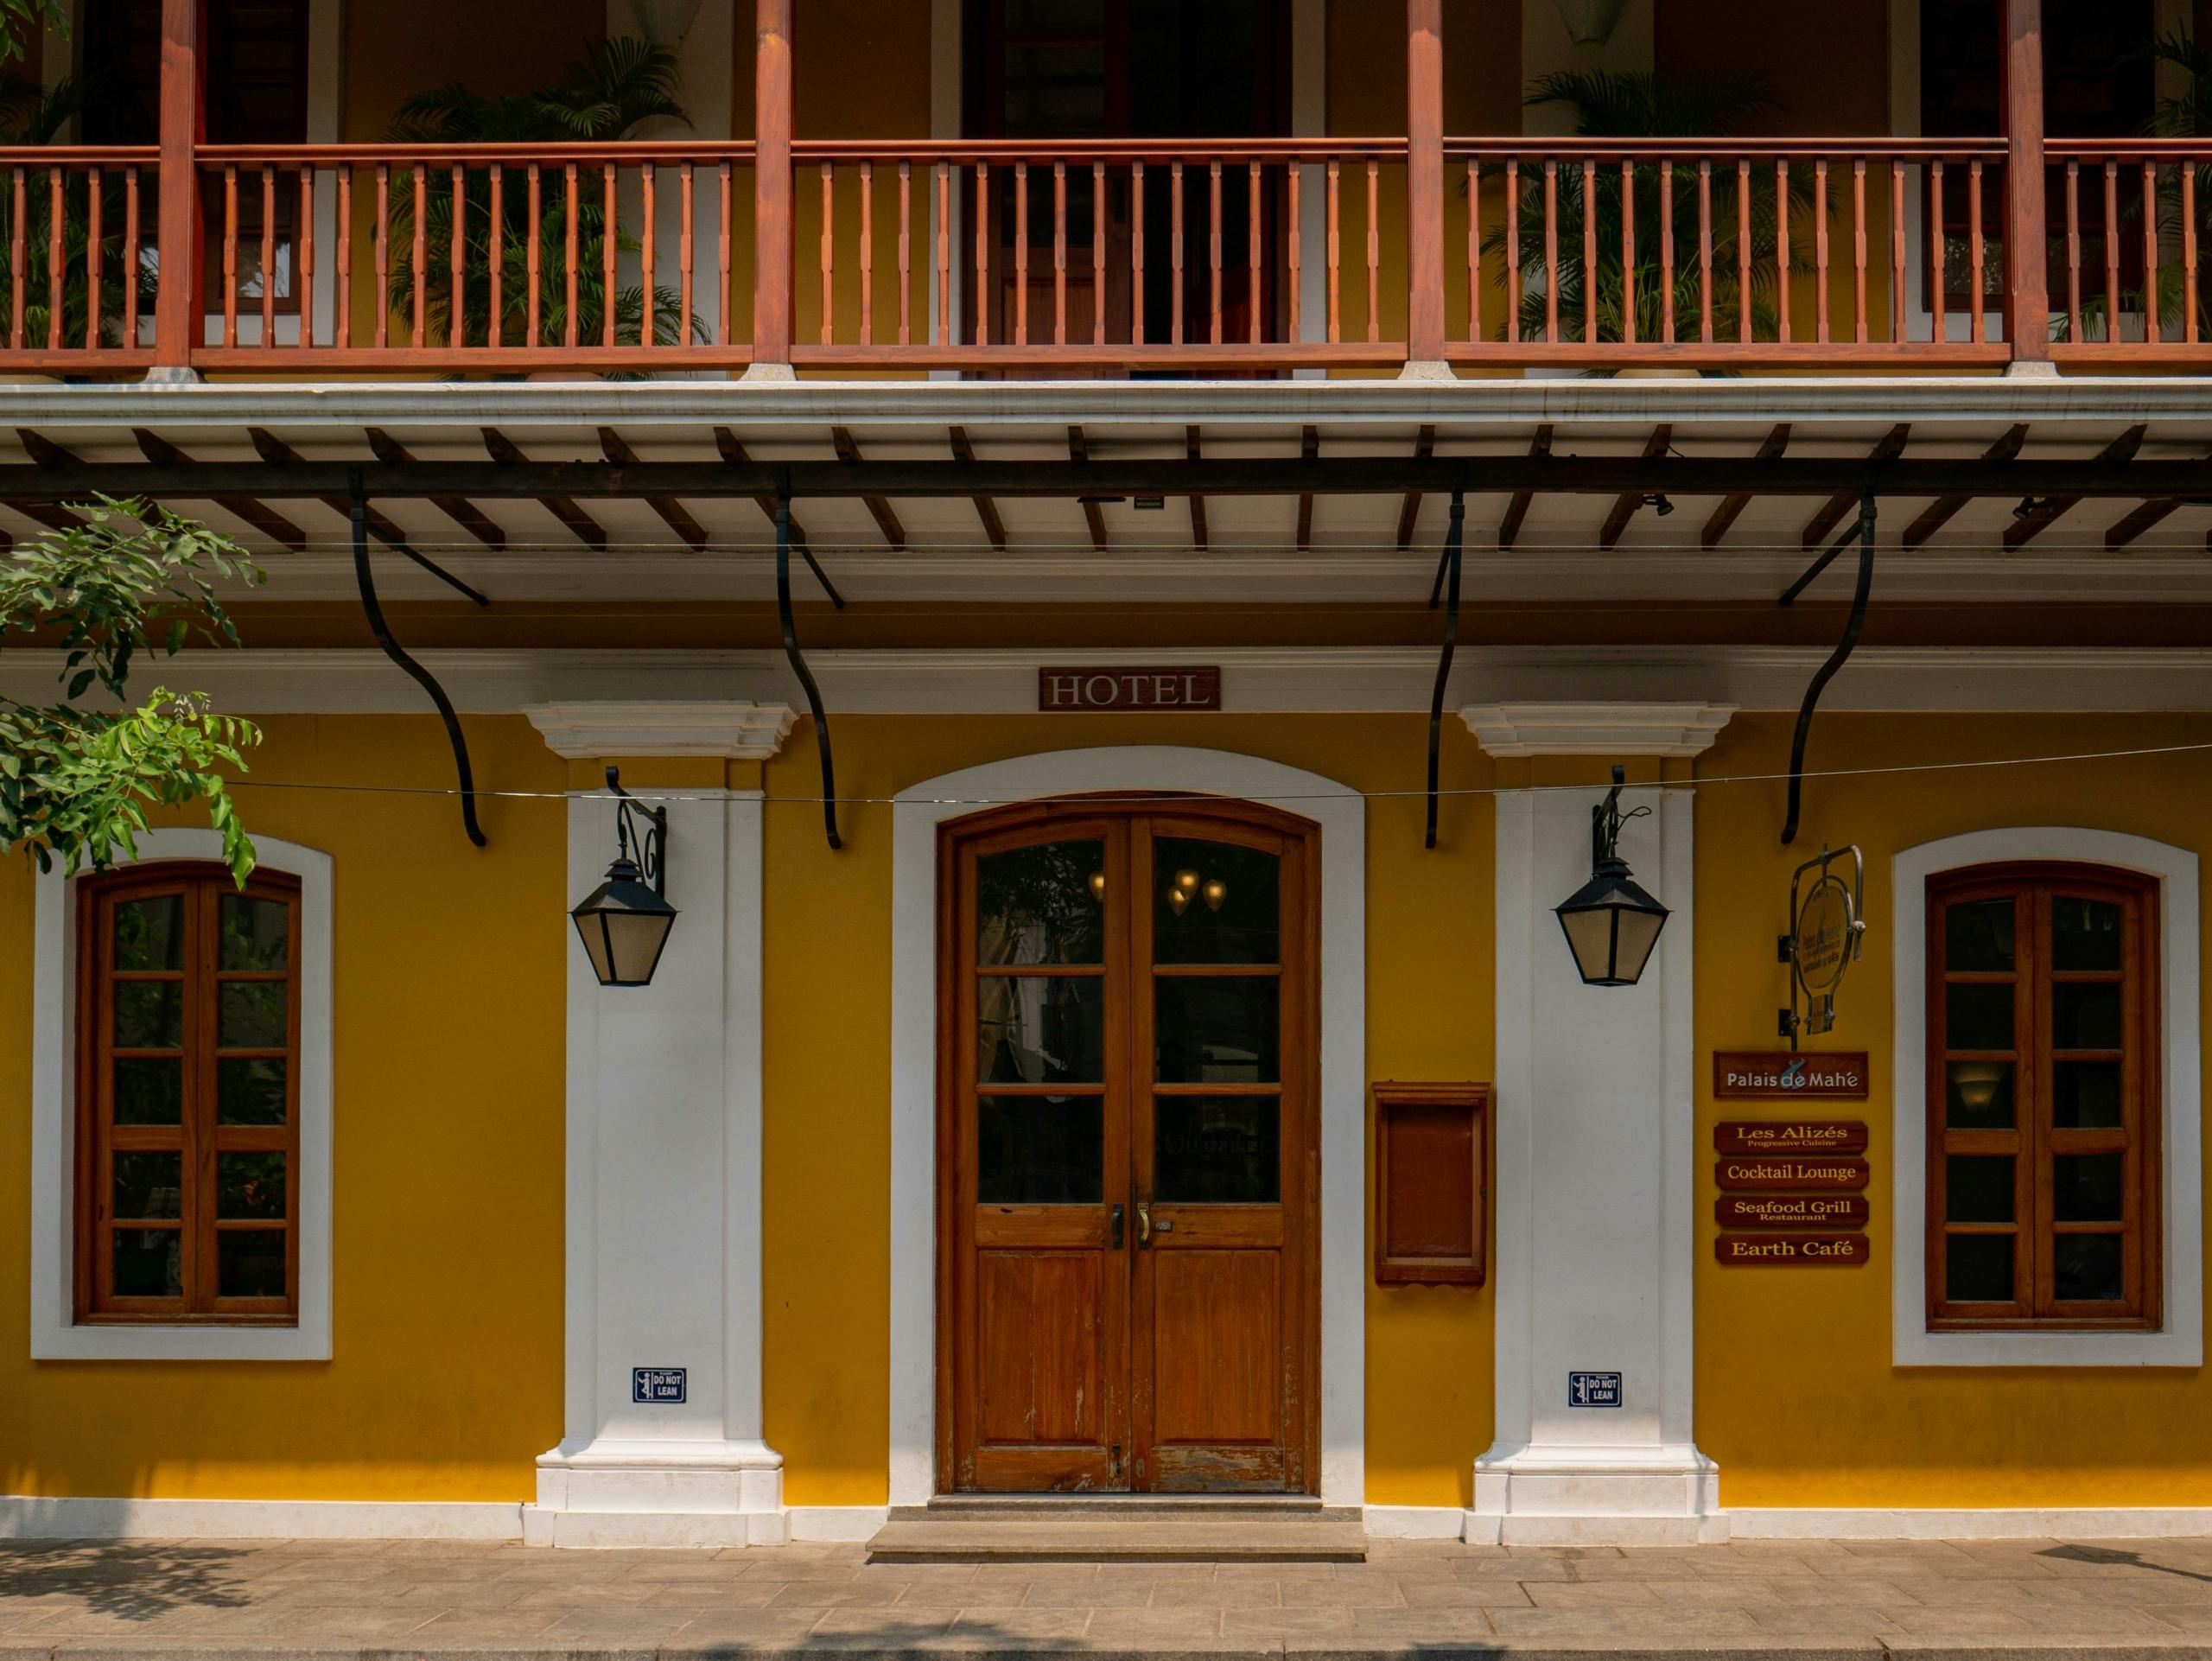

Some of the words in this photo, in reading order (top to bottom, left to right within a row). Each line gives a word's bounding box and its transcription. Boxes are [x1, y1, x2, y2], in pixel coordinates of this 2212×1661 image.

[1048, 674, 1211, 705] HOTEL
[1727, 1072, 1777, 1086] Palais
[1781, 1072, 1806, 1086] de
[1808, 1072, 1859, 1086] Mahé
[1736, 1127, 1775, 1139] Les
[1781, 1126, 1847, 1138] Alizés
[1727, 1164, 1792, 1179] Cocktail
[1796, 1165, 1857, 1181] Lounge
[1734, 1201, 1806, 1213] Seafood
[1810, 1200, 1851, 1213] Grill
[1731, 1241, 1796, 1256] Earth
[1802, 1240, 1853, 1256] Café
[653, 1375, 664, 1384] DO
[665, 1375, 681, 1384] NOT
[1589, 1379, 1600, 1389] DO
[1601, 1379, 1617, 1389] NOT
[658, 1386, 677, 1396] LEAN
[1593, 1391, 1613, 1400] LEAN
